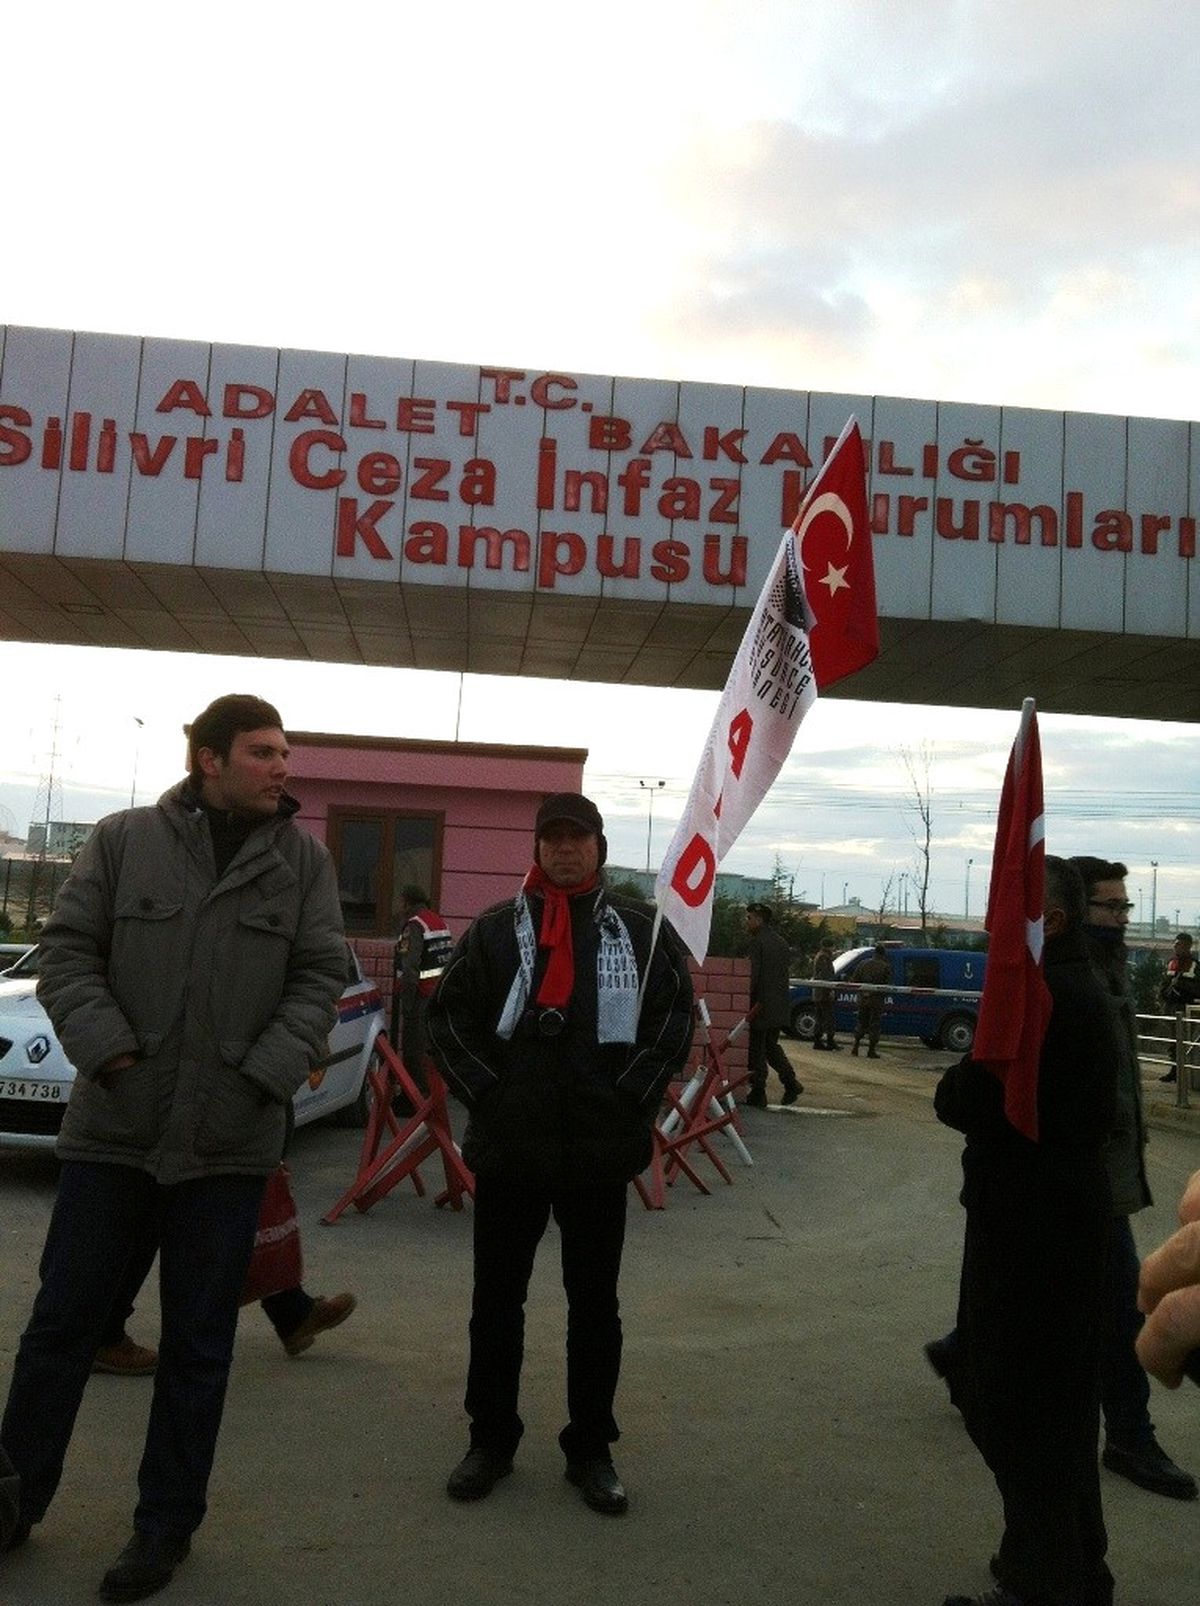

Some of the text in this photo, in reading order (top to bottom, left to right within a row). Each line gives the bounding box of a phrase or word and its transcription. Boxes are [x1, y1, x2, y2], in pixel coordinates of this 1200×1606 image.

[156, 379, 491, 437] ADALET
[481, 367, 593, 412] T.C.
[0, 406, 245, 482] Silivri
[288, 429, 497, 506] Ceza
[536, 437, 741, 525] İnfaz
[335, 497, 748, 588] Kampusü
